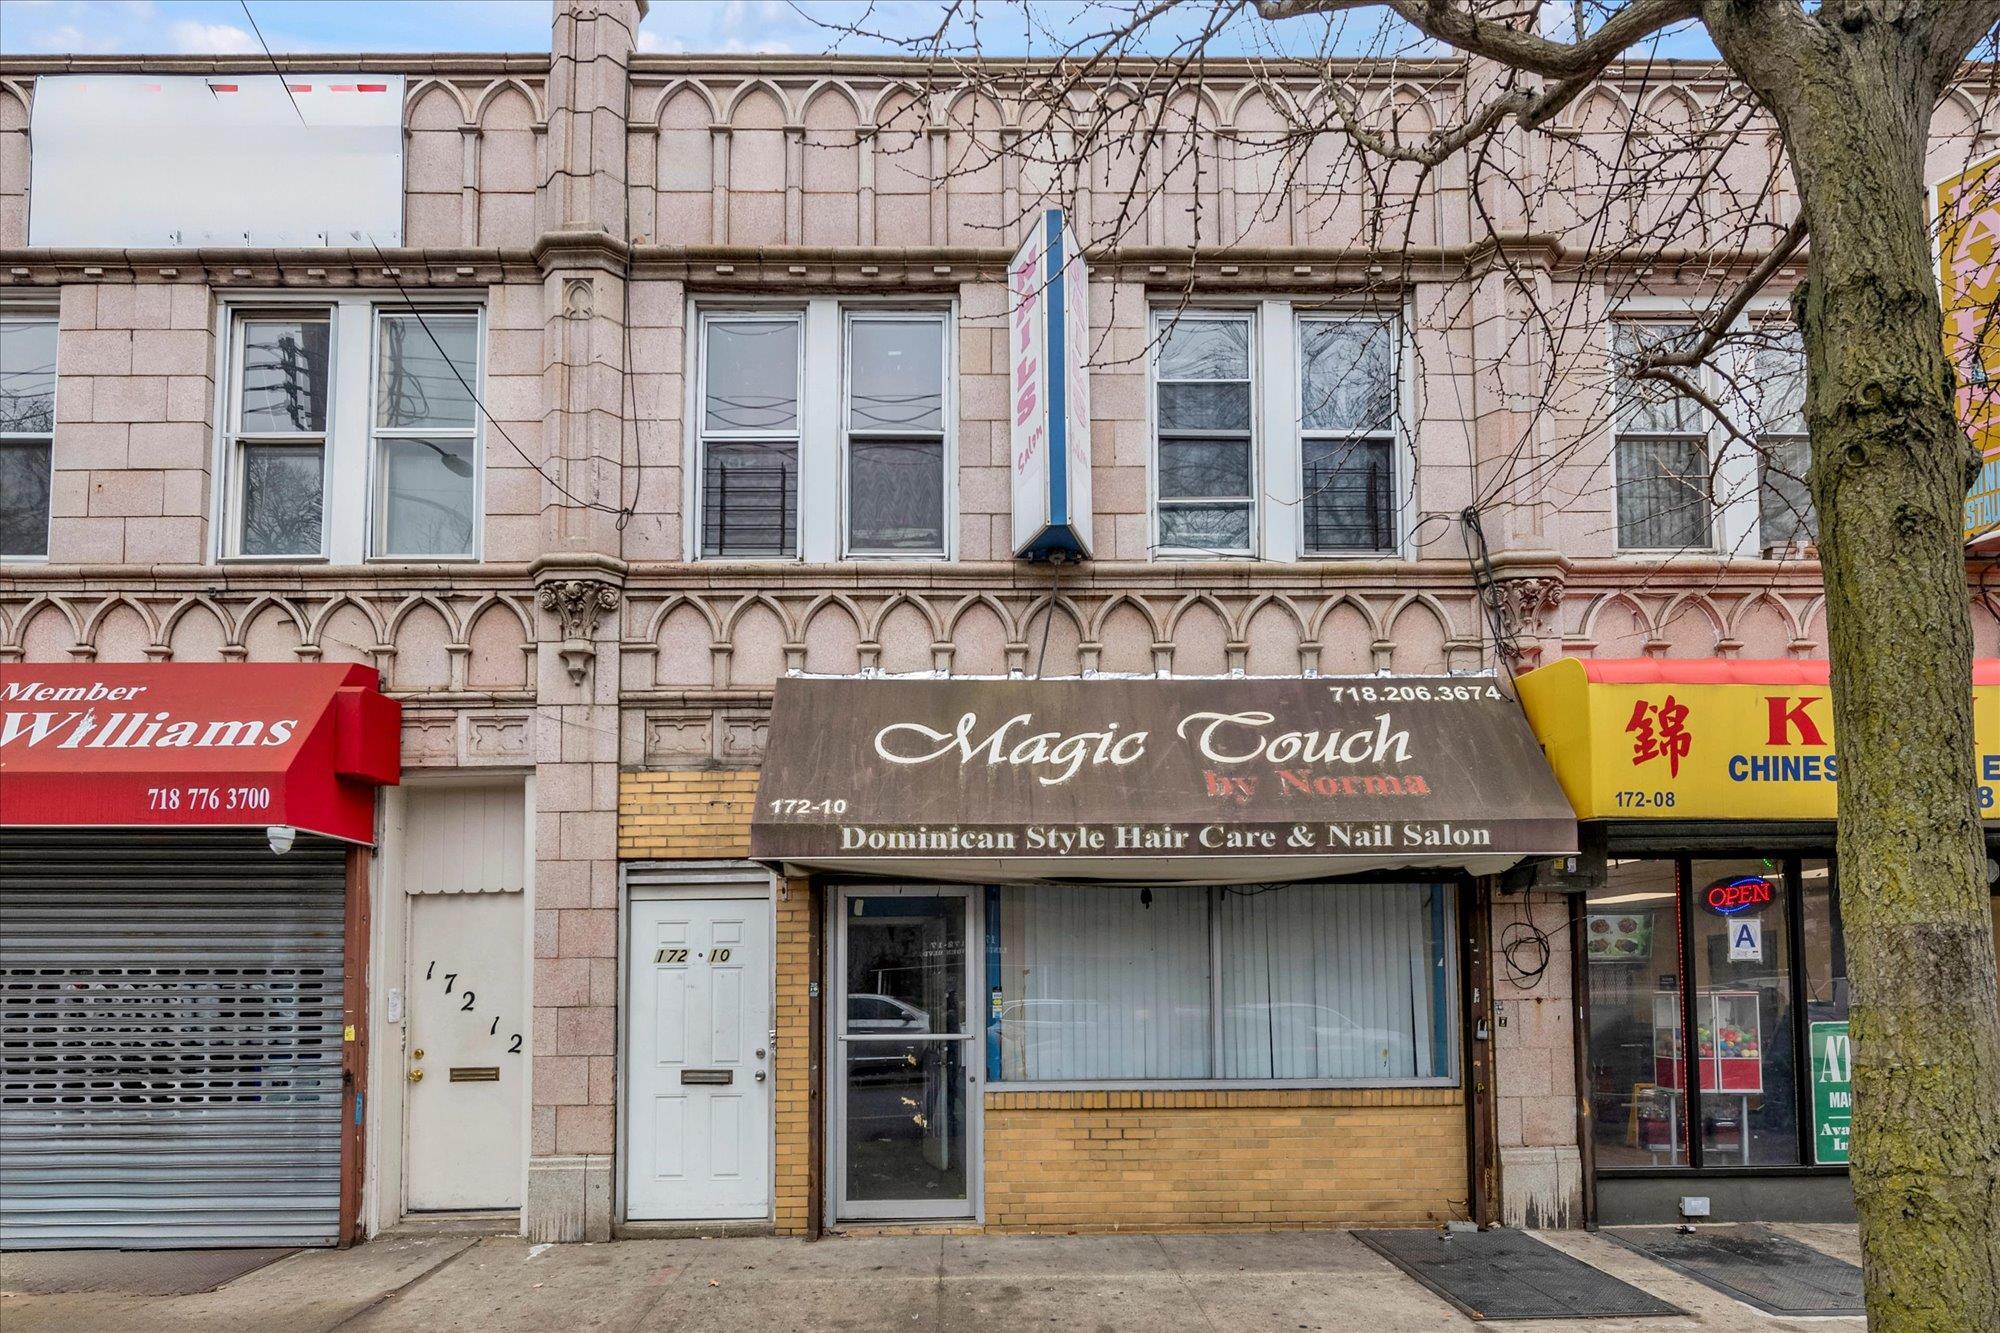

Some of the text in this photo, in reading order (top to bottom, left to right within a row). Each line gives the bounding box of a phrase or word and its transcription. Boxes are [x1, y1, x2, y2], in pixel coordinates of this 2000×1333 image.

[1016, 243, 1038, 427] NAILS
[0, 683, 147, 701] Member
[1329, 686, 1502, 702] 718.206.3674
[0, 707, 299, 749] Williams
[1625, 695, 1692, 779] 錦
[874, 711, 1413, 786] Magic Touch
[1728, 755, 1838, 782] CHINES
[148, 787, 270, 810] 718 776 3700
[1204, 768, 1431, 802] by Norma
[771, 799, 847, 815] 172-10
[1615, 791, 1675, 808] 172-08
[841, 822, 1491, 855] Dominican Style Hair Care & Nail Salon
[1708, 882, 1770, 908] OPEN
[1735, 923, 1756, 948] A
[656, 949, 731, 963] 172 10
[426, 961, 476, 1011] 172
[489, 1016, 523, 1054] 12
[1819, 1035, 1852, 1083] AT
